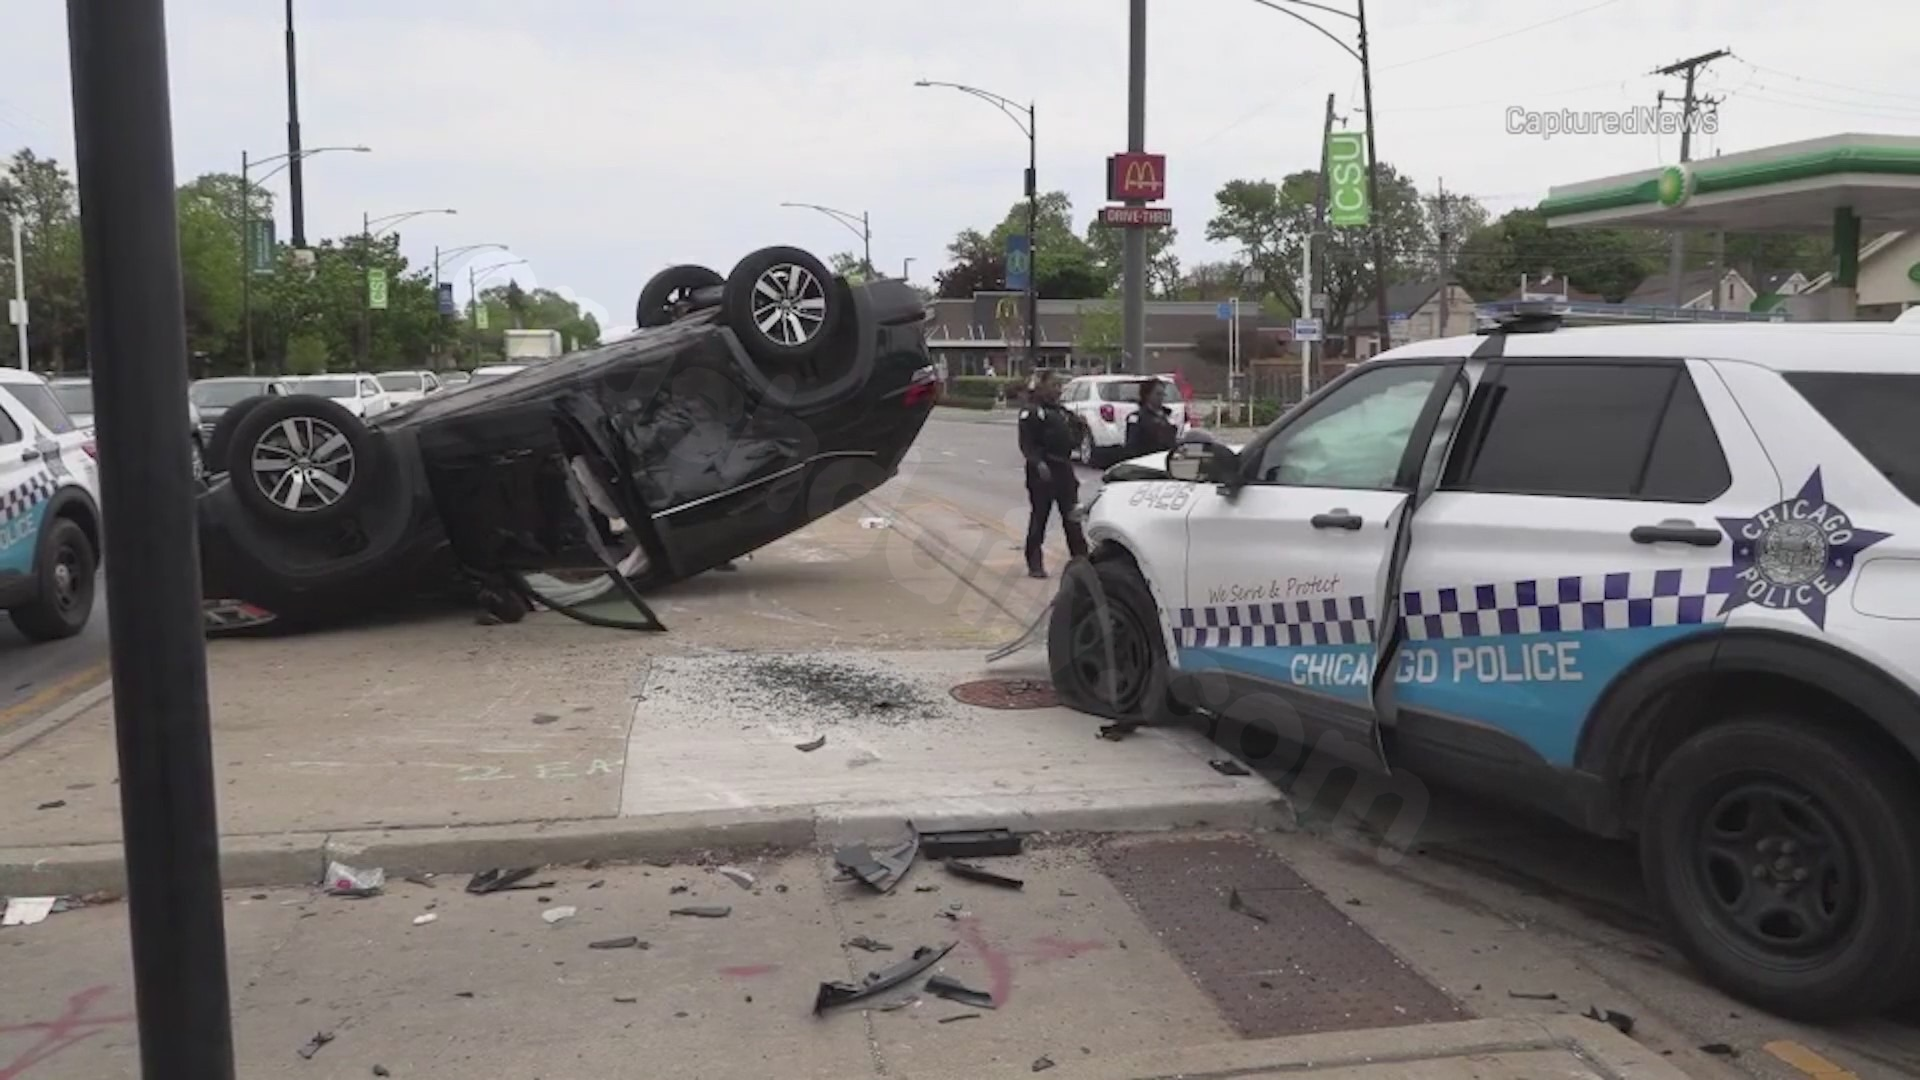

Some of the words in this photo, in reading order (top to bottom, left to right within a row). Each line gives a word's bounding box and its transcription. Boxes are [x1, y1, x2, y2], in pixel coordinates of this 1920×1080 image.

[1332, 137, 1364, 211] CSU
[1106, 209, 1171, 224] DRIVE-THRU
[1741, 498, 1853, 546] CHICAGO
[1208, 585, 1230, 605] We
[1231, 583, 1266, 603] Serve
[1286, 574, 1341, 599] Protect
[1736, 566, 1836, 608] POLICE
[1290, 648, 1439, 686] CHICAGO
[1452, 640, 1584, 684] POLICE
